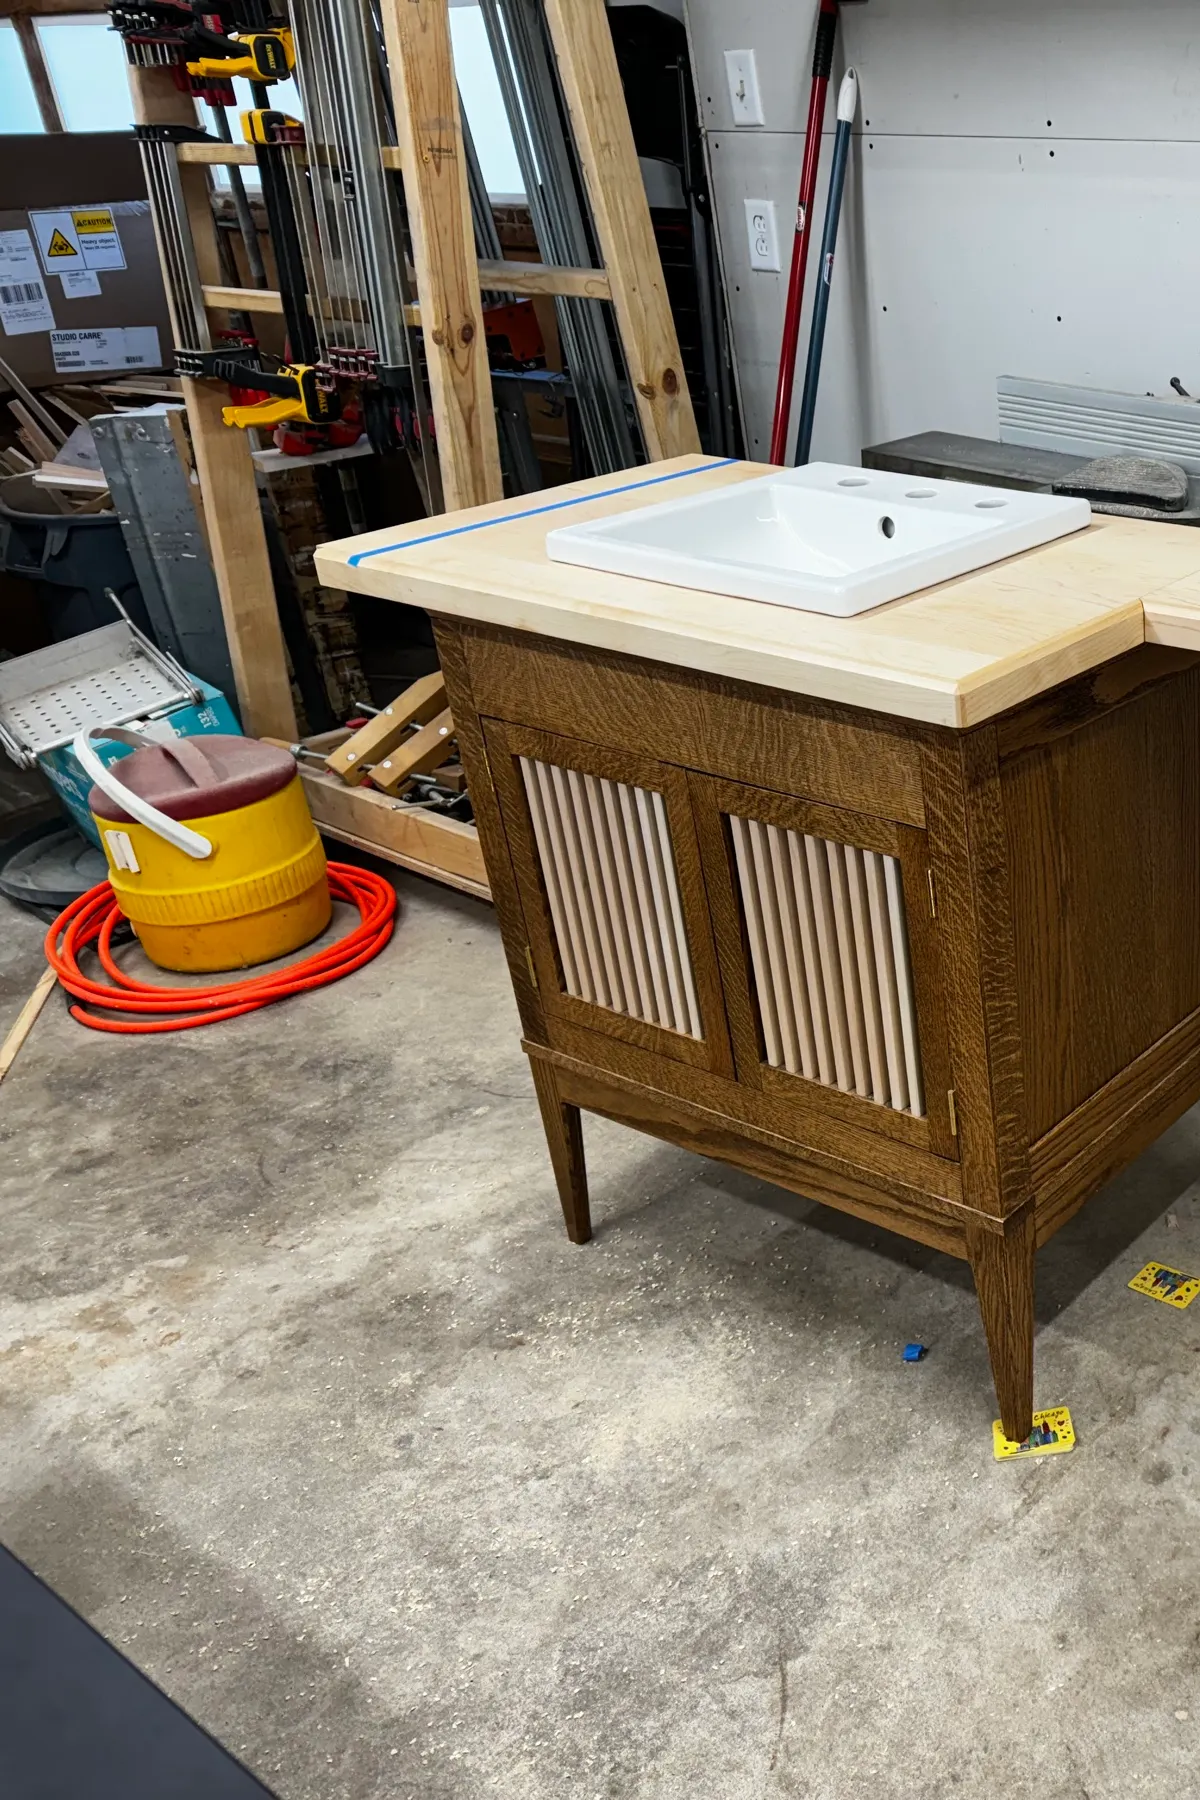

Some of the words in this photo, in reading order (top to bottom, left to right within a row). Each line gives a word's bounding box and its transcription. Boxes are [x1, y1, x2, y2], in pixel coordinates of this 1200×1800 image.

[82, 217, 112, 226] CAUTION
[52, 333, 77, 342] STUDIO
[197, 711, 212, 728] 132
[1034, 1410, 1064, 1421] Chicago
